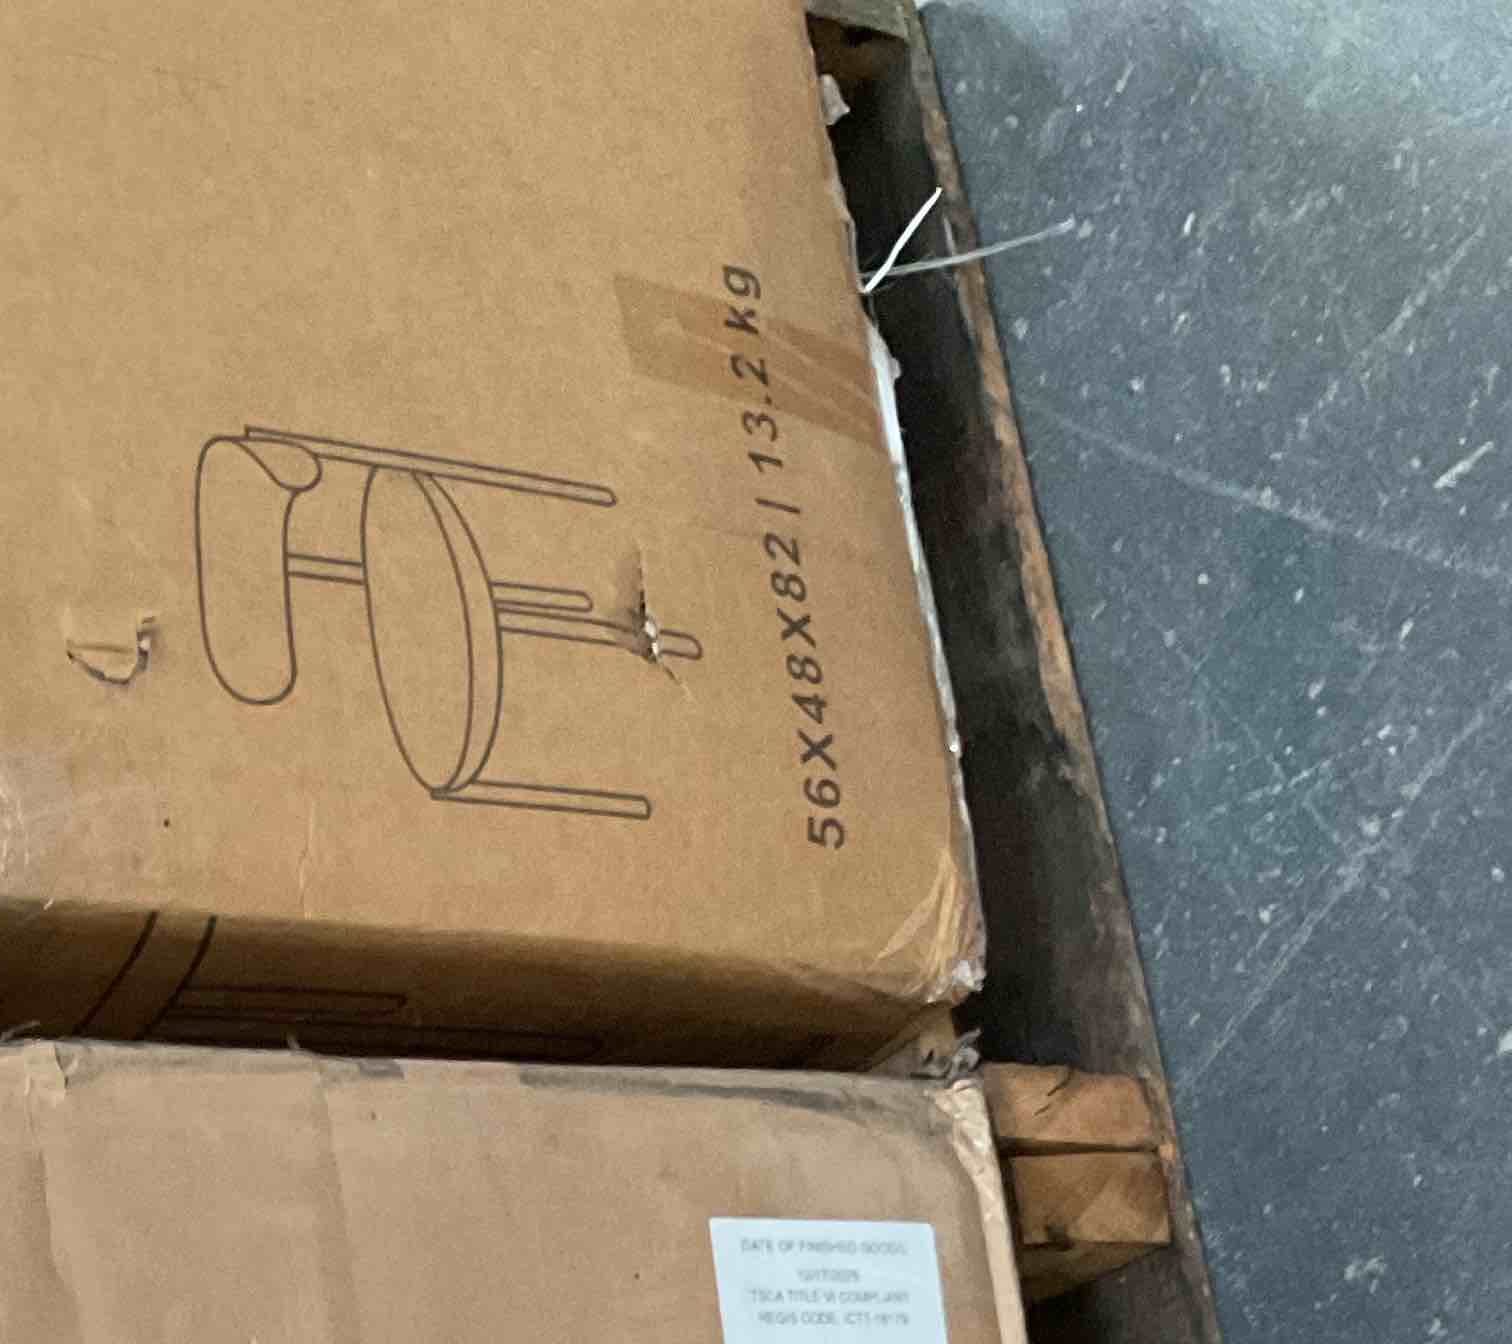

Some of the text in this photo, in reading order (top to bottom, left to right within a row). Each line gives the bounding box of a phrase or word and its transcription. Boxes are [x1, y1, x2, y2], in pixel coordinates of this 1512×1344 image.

[724, 266, 764, 338] kg
[730, 354, 784, 475] 13.2
[763, 531, 847, 850] 56X48X82
